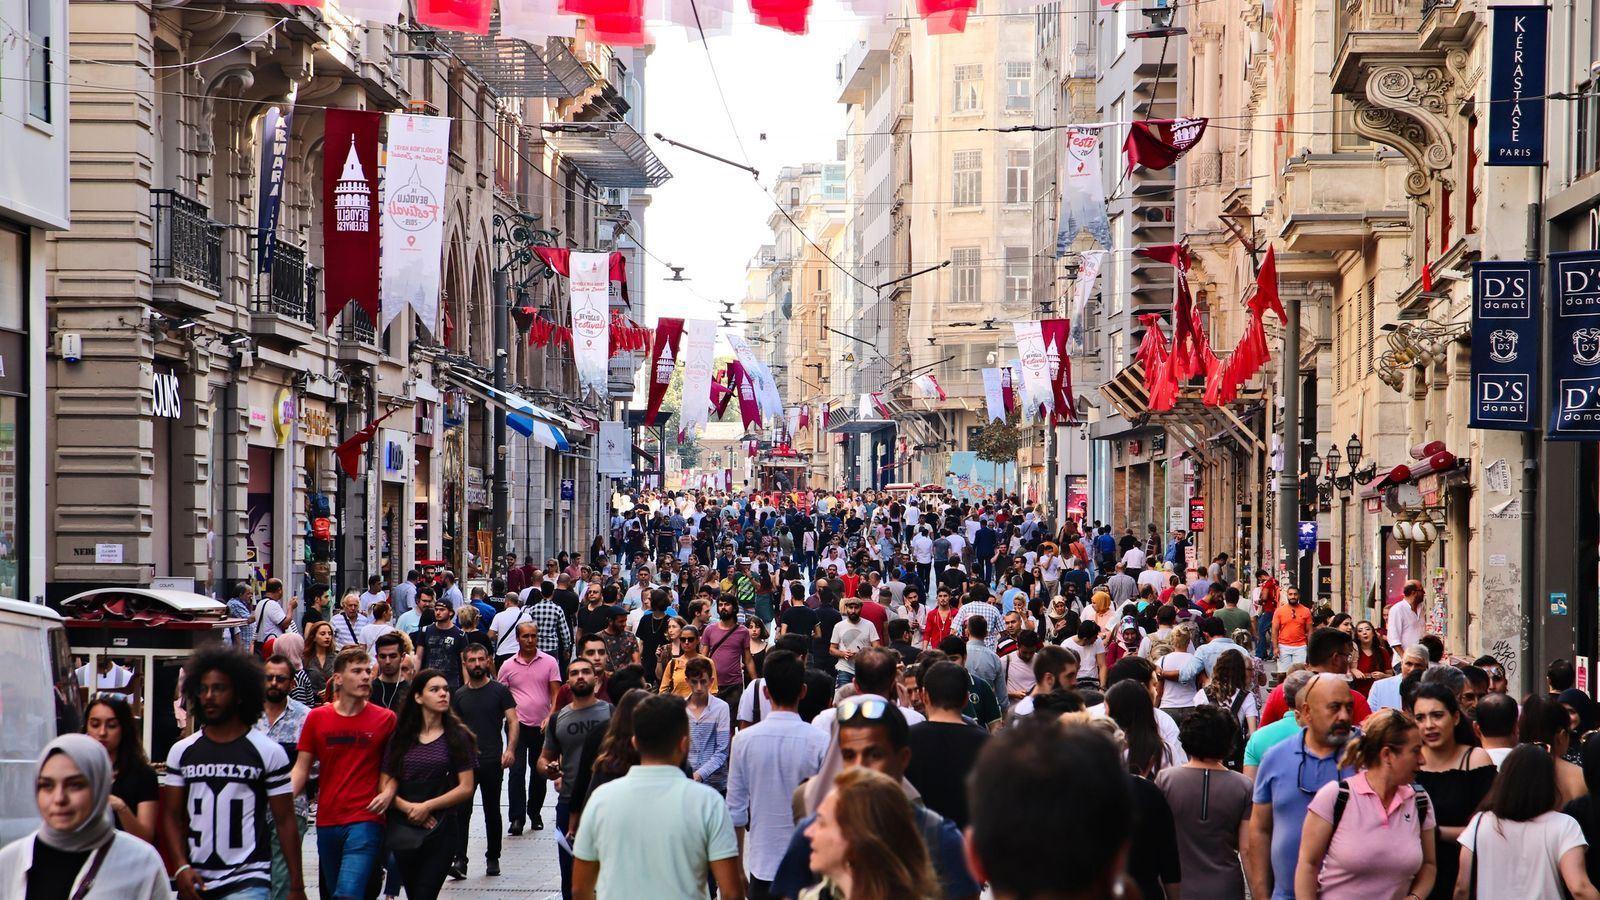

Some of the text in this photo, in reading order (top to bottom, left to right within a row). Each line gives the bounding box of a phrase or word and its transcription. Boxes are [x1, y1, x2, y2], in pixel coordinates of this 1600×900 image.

[1511, 16, 1526, 142] KÉRASTASE
[1499, 149, 1531, 157] PARIS
[1484, 277, 1525, 298] D'S
[1484, 301, 1525, 309] damat
[1581, 343, 1596, 352] D'S
[1482, 381, 1524, 401] D'S
[1482, 404, 1524, 413] damat
[181, 763, 262, 780] BROOKLYN
[187, 782, 256, 866] 90
